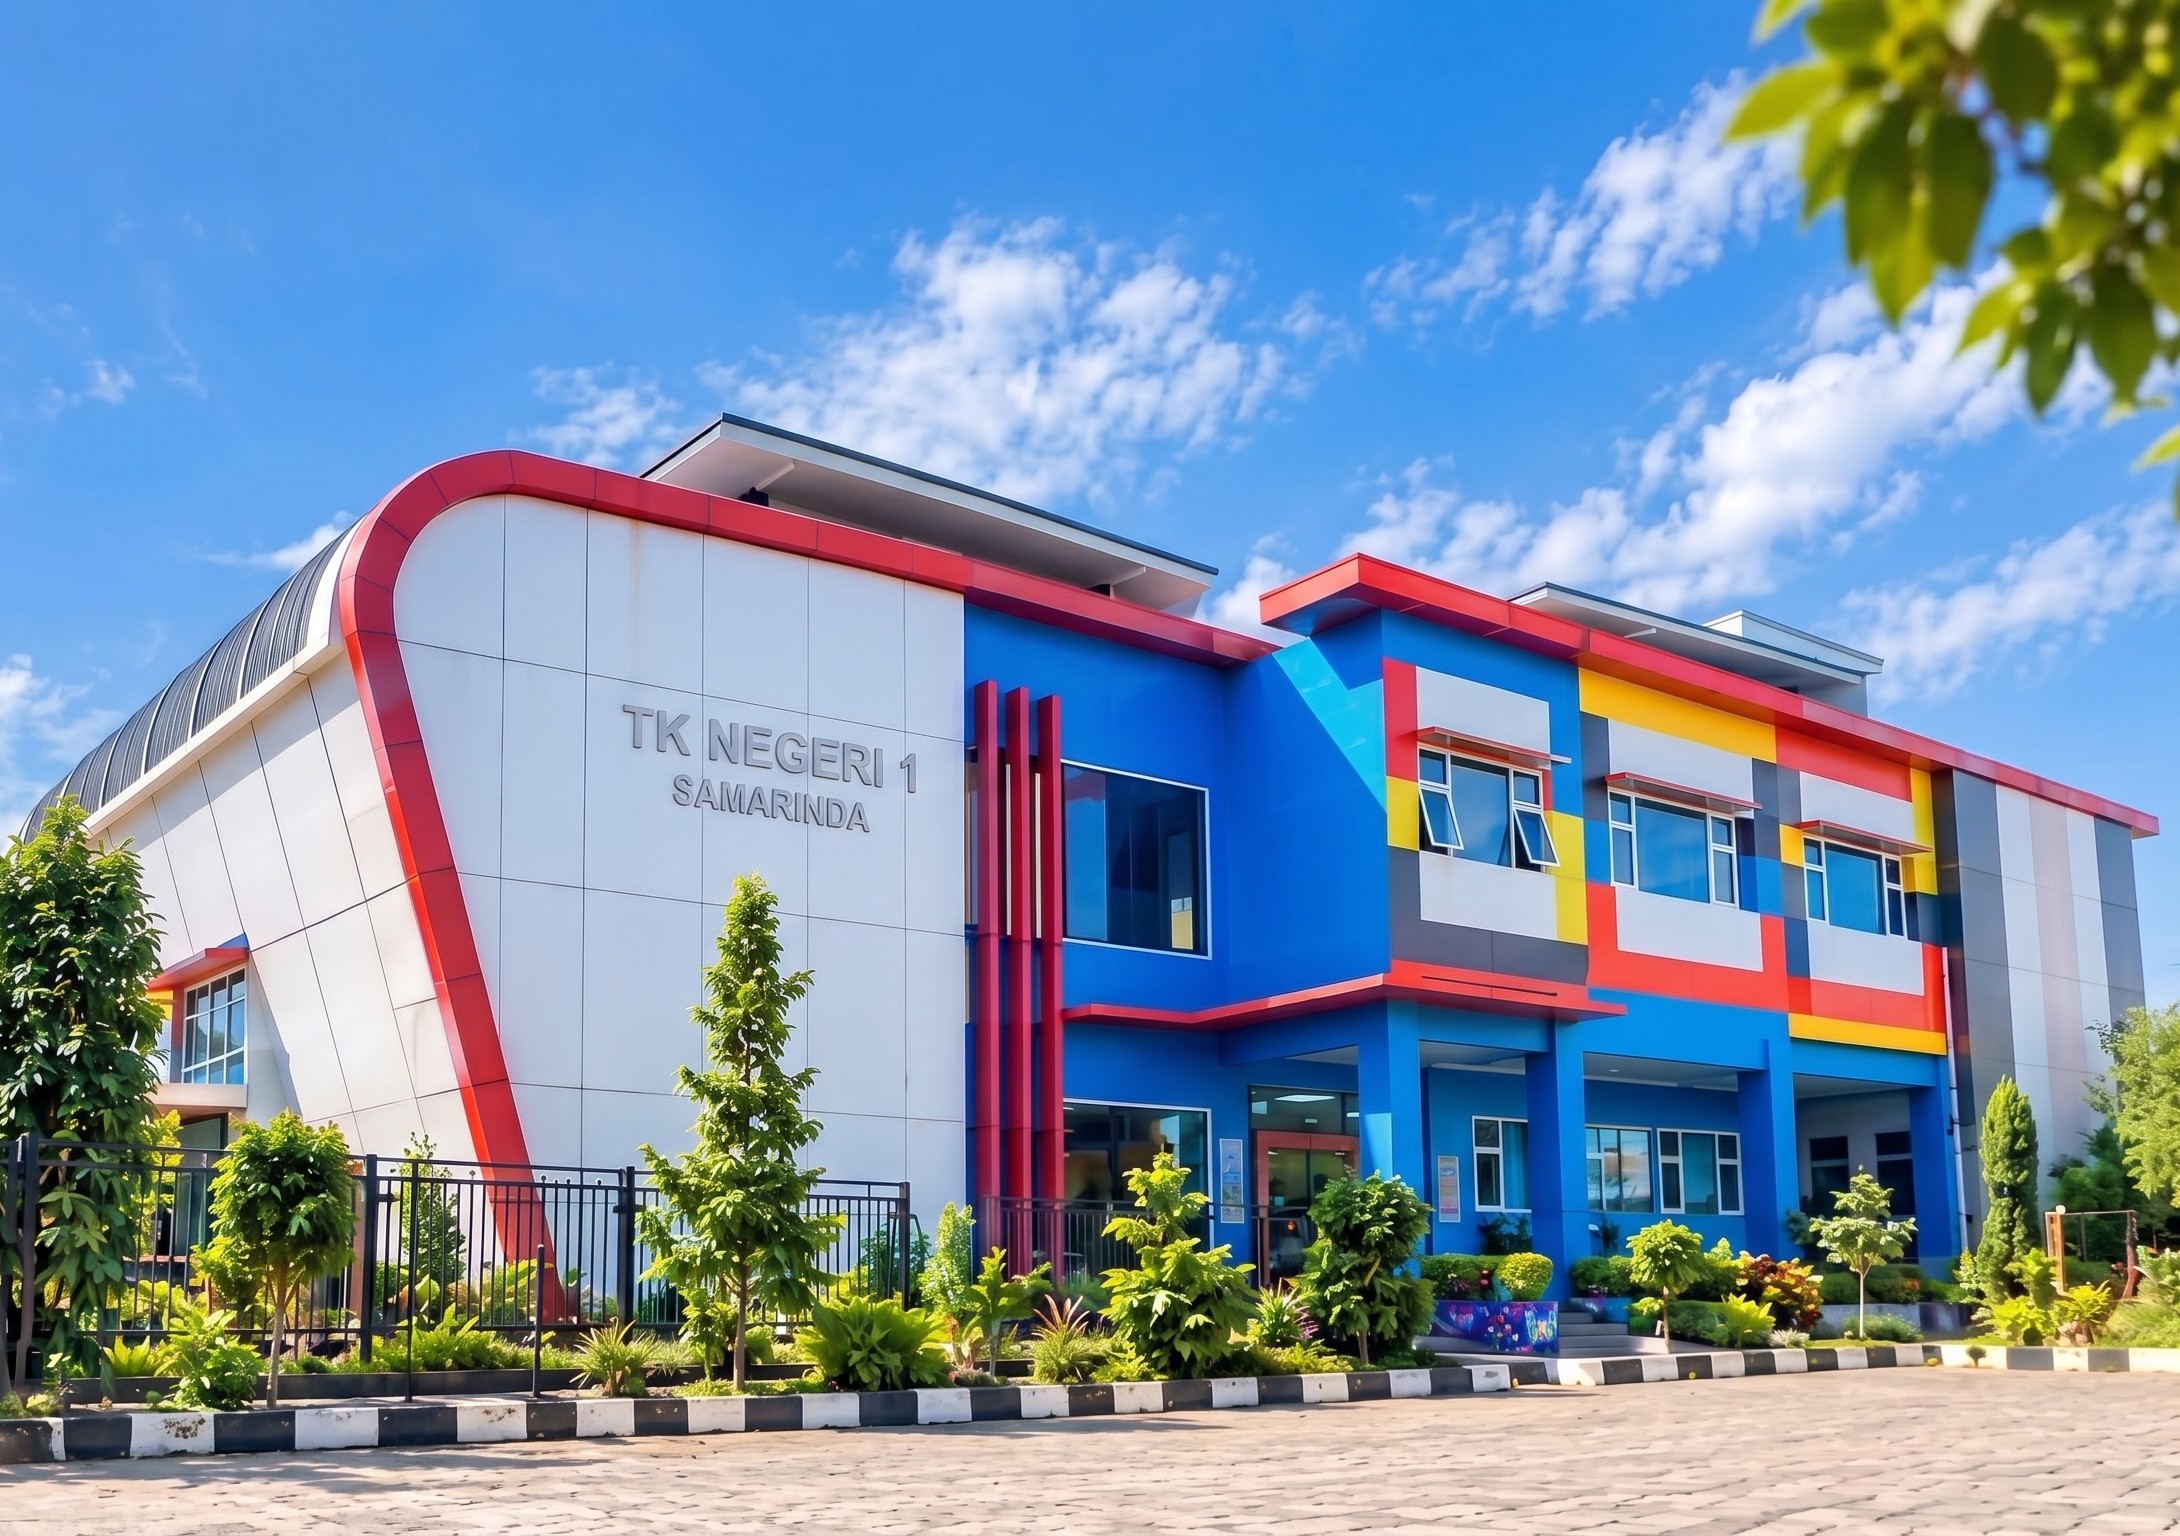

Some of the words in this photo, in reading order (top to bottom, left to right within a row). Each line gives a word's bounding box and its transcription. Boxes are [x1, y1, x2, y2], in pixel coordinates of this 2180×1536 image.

[622, 704, 691, 756] TK
[708, 718, 884, 788] NEGERI
[900, 753, 918, 793] 1
[672, 774, 871, 833] SAMARINDA
